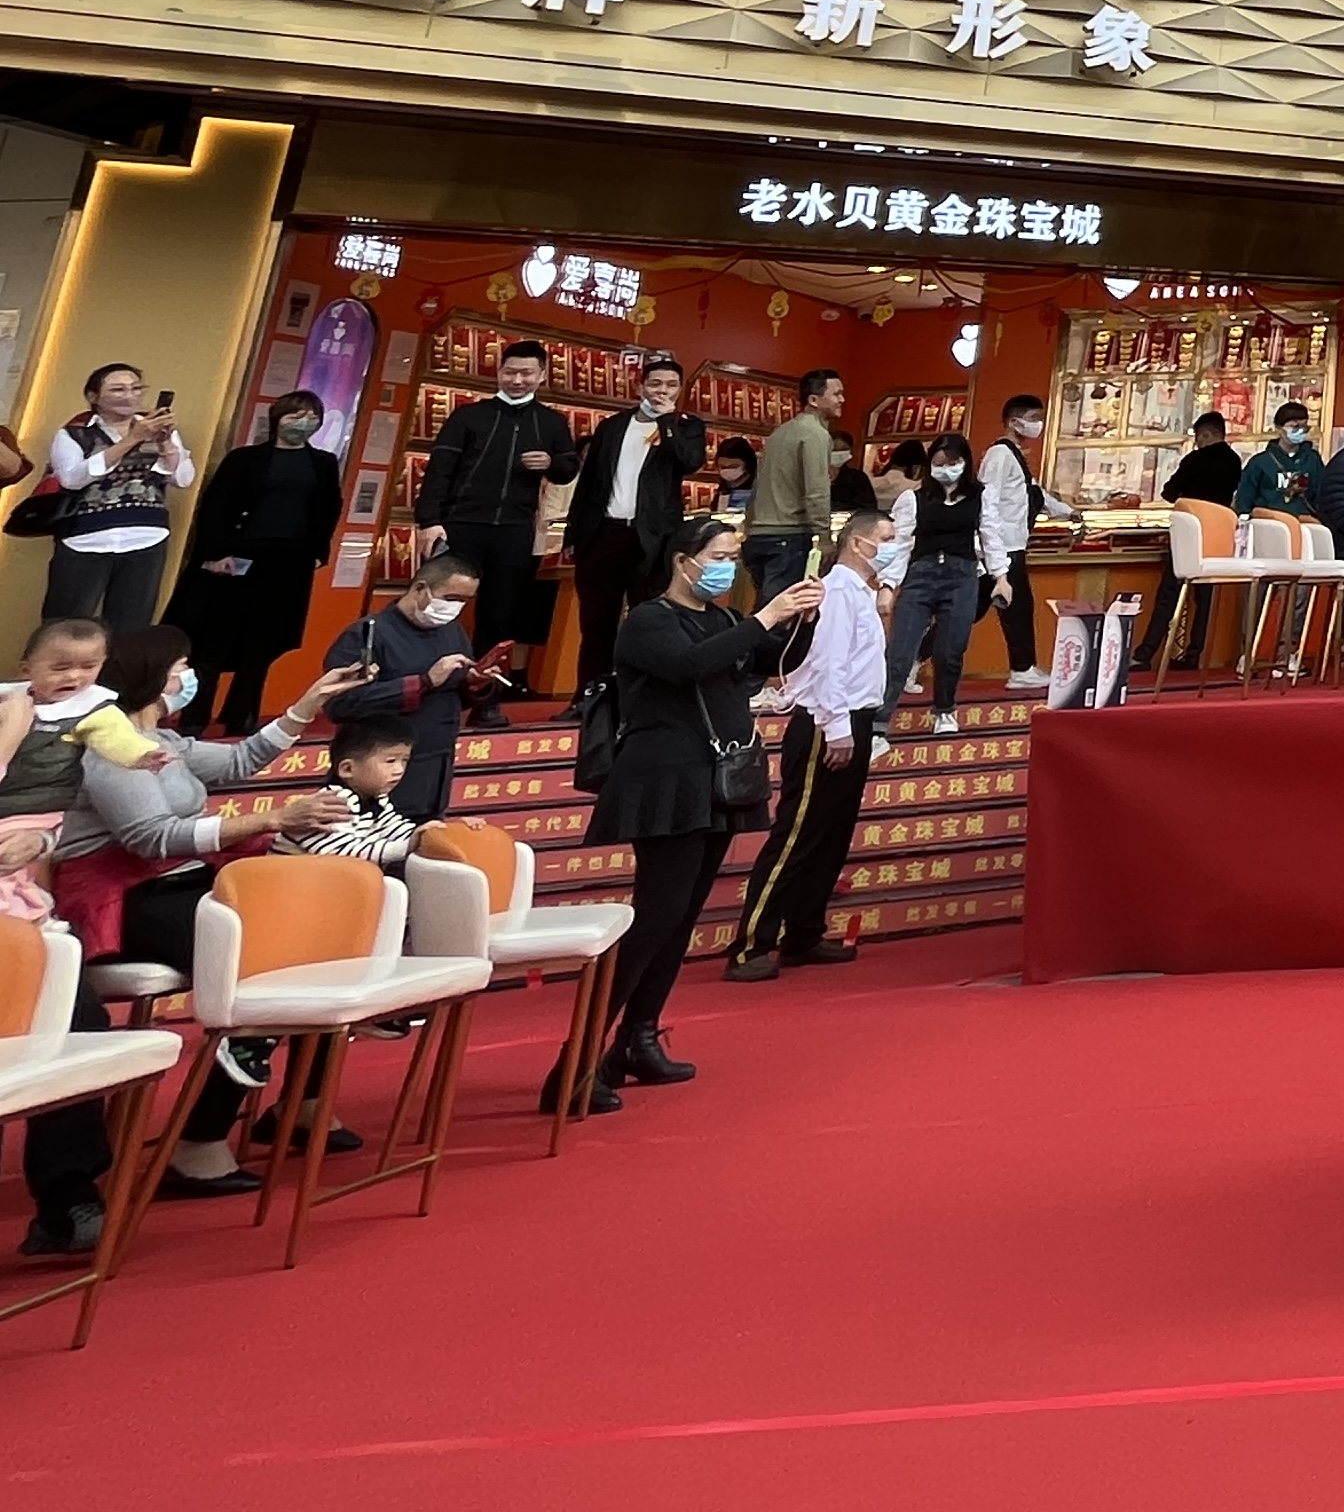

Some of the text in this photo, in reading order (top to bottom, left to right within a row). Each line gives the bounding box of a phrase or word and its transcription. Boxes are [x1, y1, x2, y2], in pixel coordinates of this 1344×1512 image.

[738, 177, 1103, 245] 老水贝黄金珠宝城
